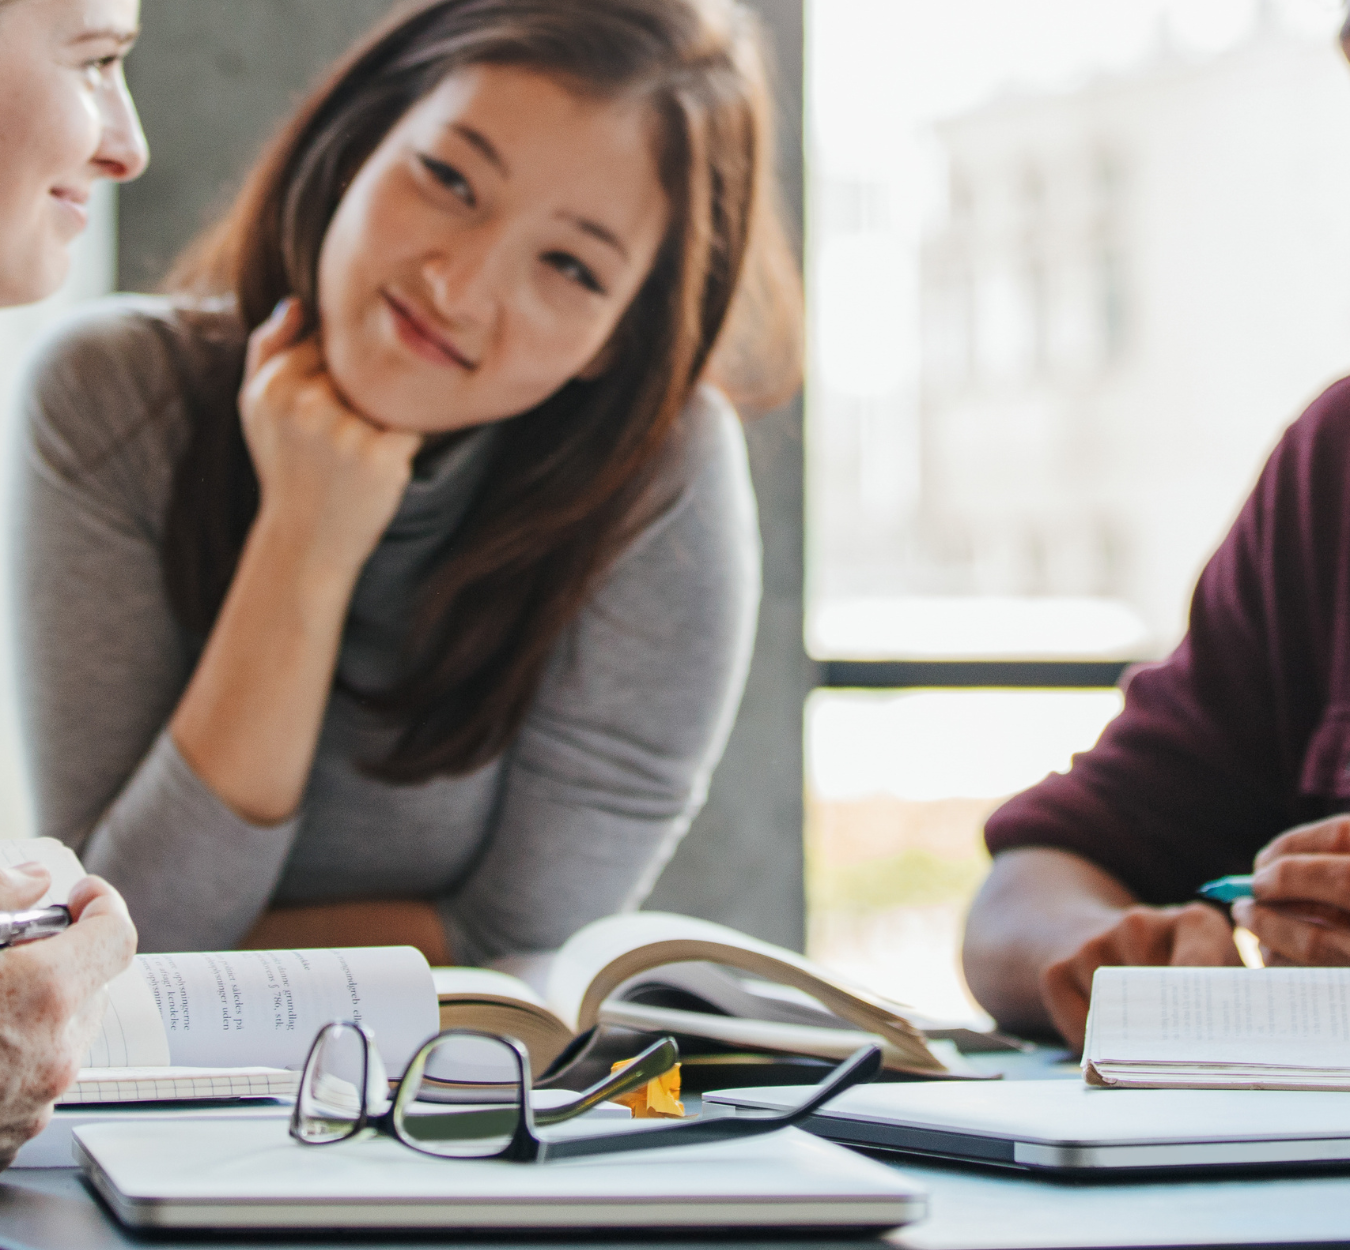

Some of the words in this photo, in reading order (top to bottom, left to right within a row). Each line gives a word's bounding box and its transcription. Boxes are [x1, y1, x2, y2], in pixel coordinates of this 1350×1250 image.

[166, 991, 179, 1031] kendelse
[174, 972, 191, 1031] oplysningerne
[230, 984, 244, 1015] således
[282, 989, 297, 1031] grundlag
[221, 1007, 232, 1031] uden
[233, 1018, 245, 1031] på
[275, 1013, 284, 1031] stk.
[353, 1009, 362, 1026] elle
